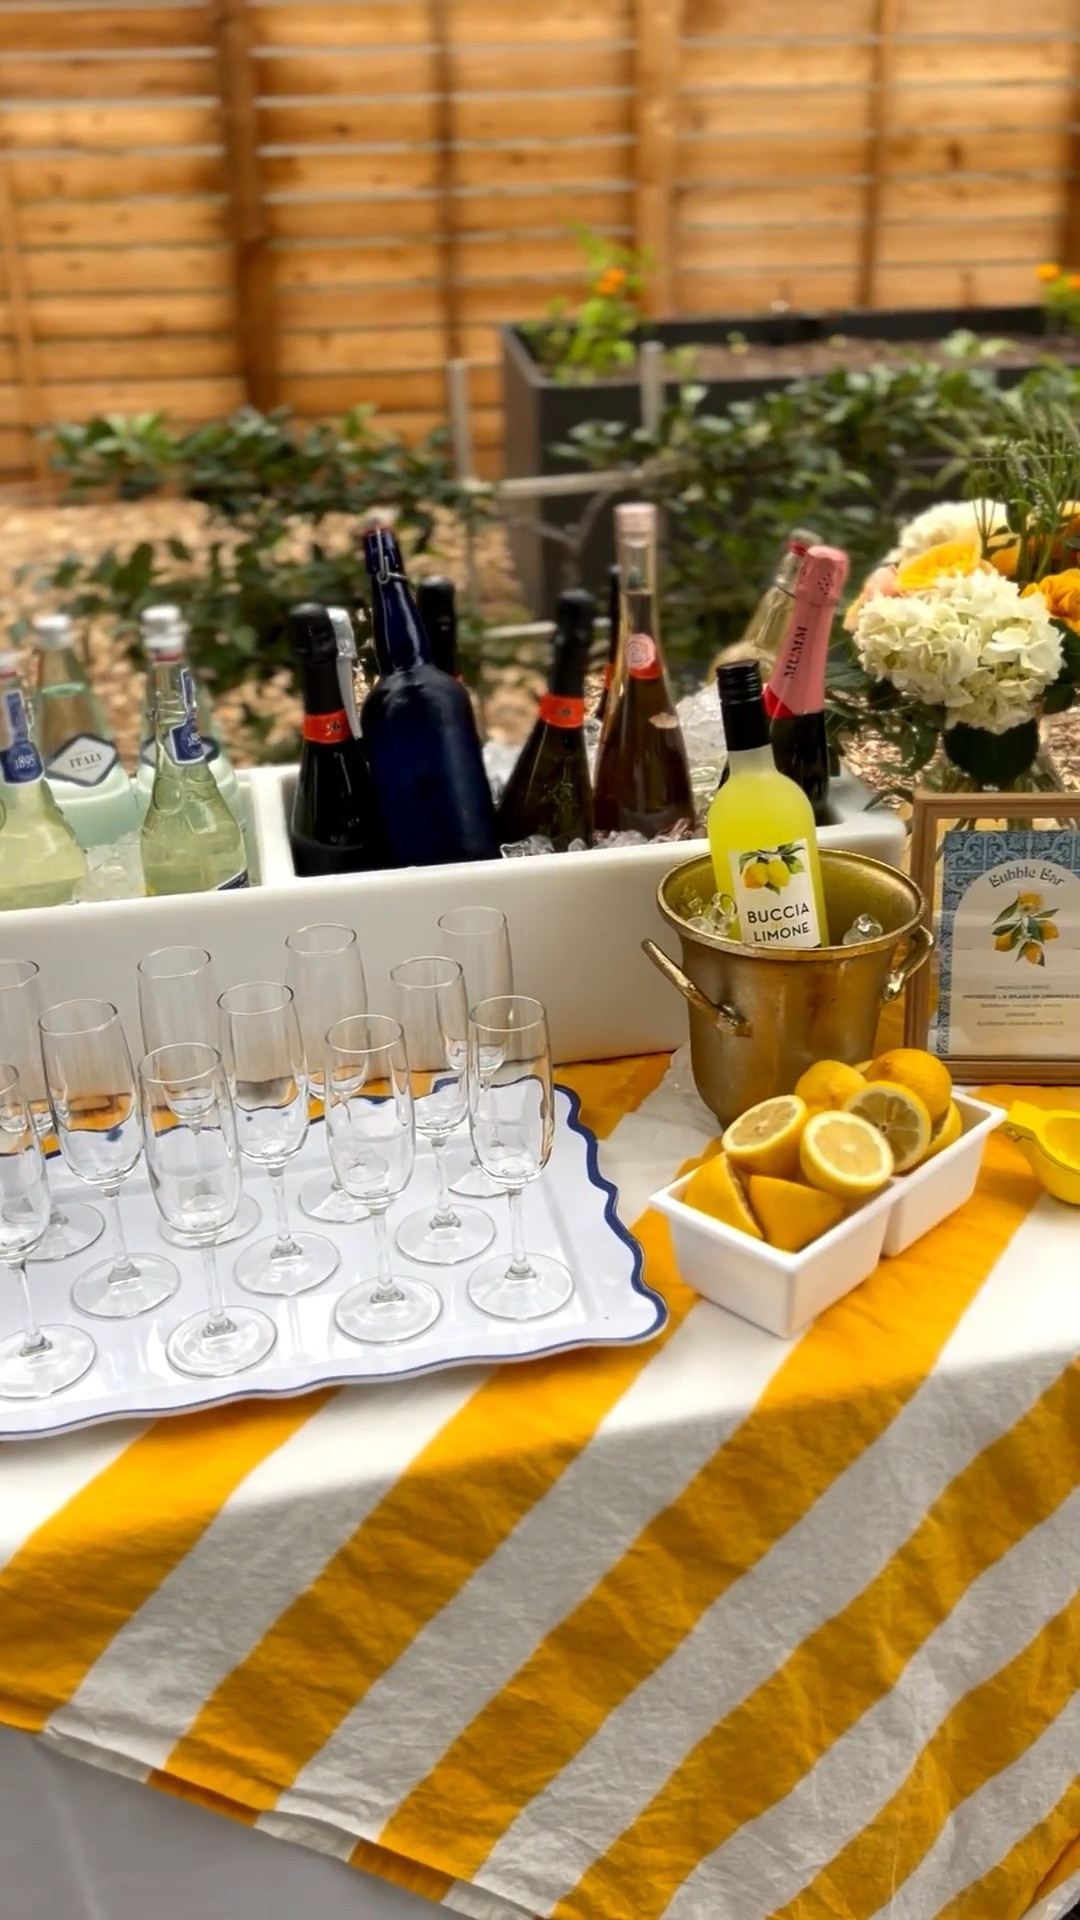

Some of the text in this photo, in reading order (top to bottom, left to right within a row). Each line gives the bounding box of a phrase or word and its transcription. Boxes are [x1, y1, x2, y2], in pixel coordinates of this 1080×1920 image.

[784, 626, 807, 679] MUMM
[14, 753, 37, 770] 1895
[69, 752, 102, 769] ITALY
[988, 866, 1036, 888] Bubble
[747, 902, 809, 923] BUCCIA
[754, 921, 810, 942] LIMONE
